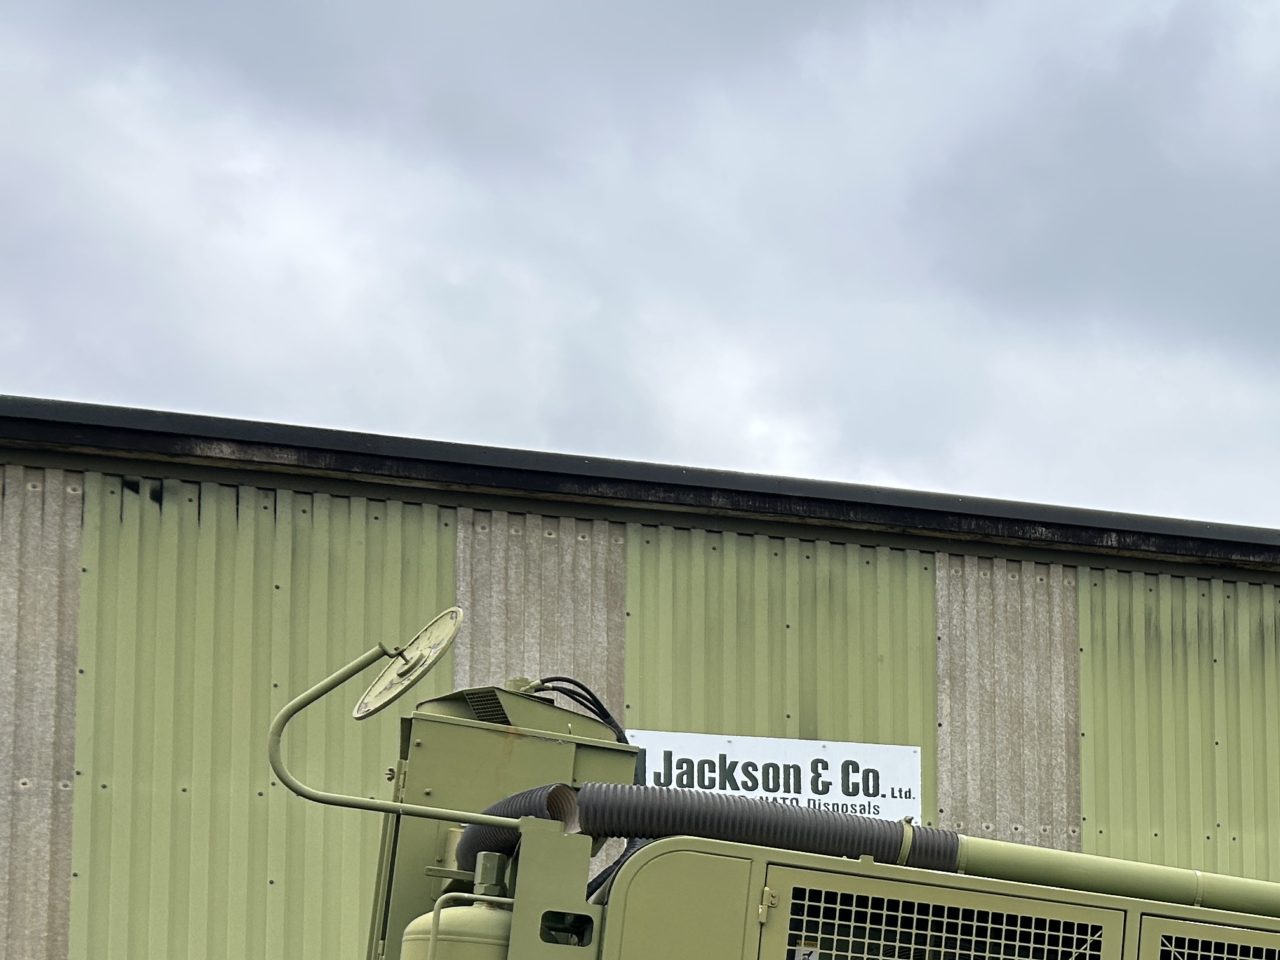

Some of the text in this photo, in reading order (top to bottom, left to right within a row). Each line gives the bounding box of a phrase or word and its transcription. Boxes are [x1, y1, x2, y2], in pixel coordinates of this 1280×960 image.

[653, 750, 802, 794] Jackson
[810, 758, 833, 796] &
[841, 760, 887, 798] Co.
[891, 787, 916, 800] Ltd.
